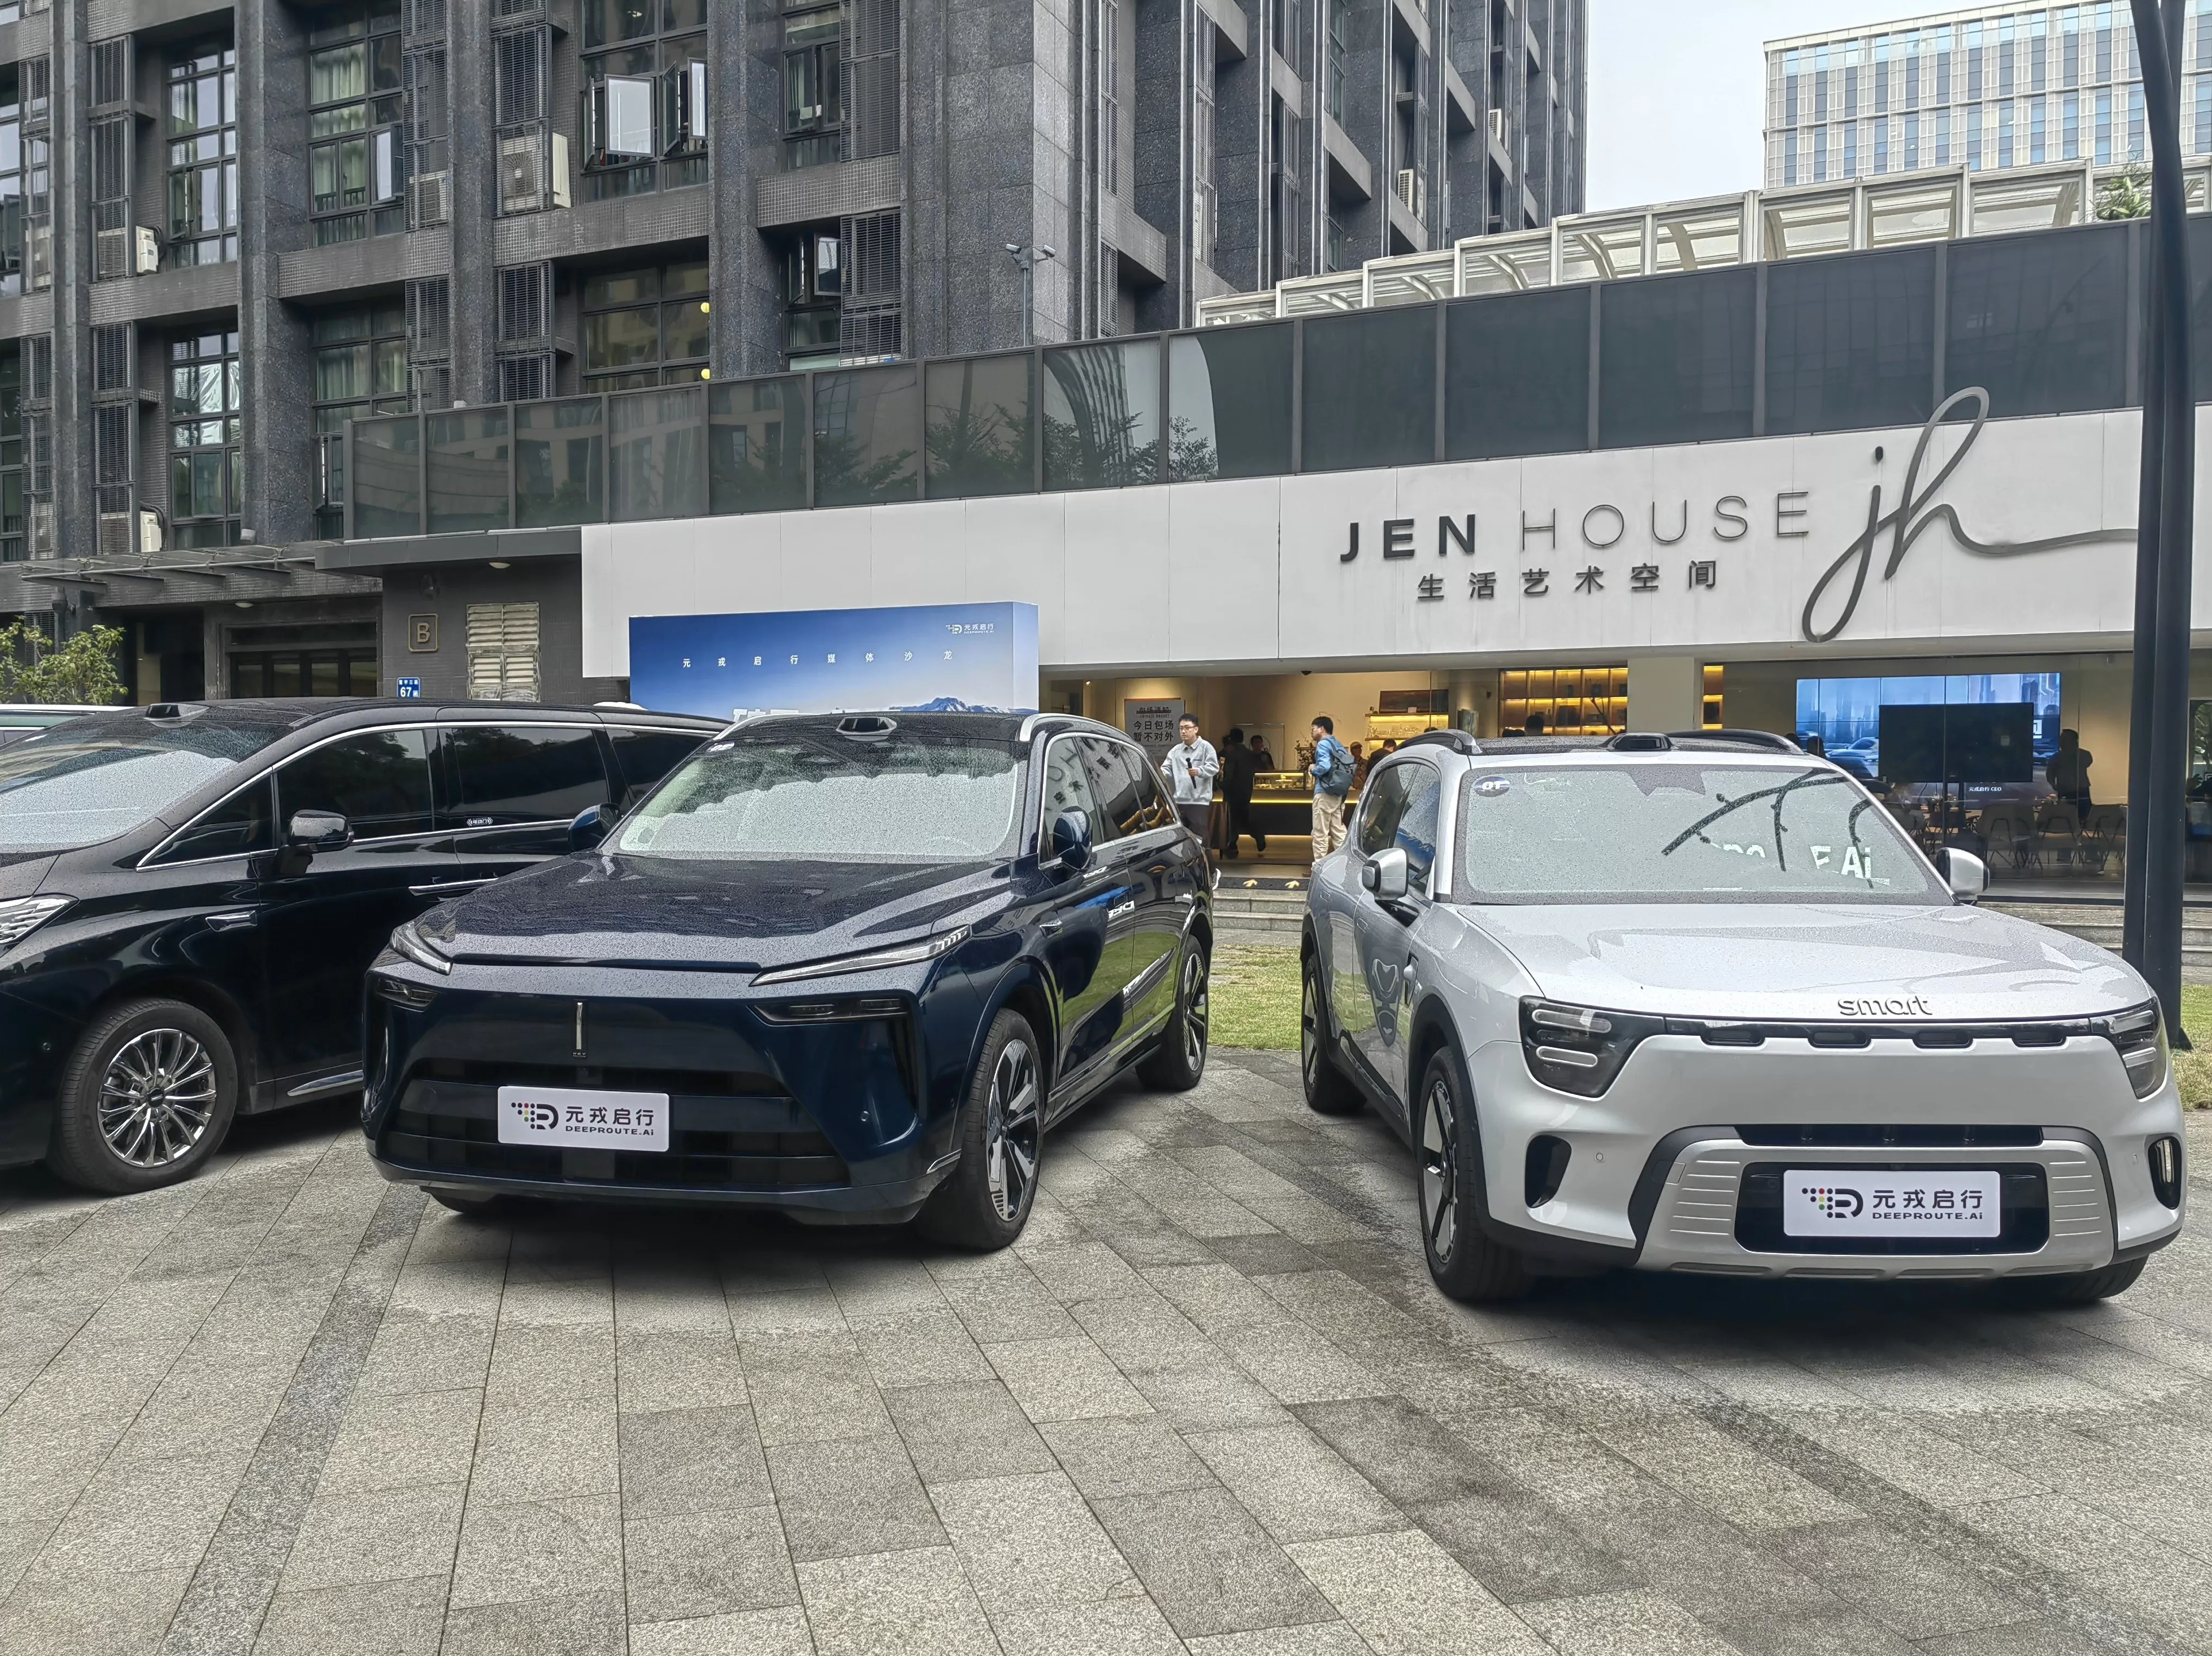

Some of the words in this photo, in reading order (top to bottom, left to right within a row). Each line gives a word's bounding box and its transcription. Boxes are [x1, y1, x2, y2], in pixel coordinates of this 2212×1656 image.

[1340, 514, 1476, 562] JEN
[1522, 491, 1809, 550] HOUSE
[1417, 560, 1717, 600] 生活艺术空间
[417, 622, 430, 642] B
[683, 649, 953, 668] 元戎启行媒体沙龙
[400, 686, 412, 697] 67
[1133, 719, 1174, 730] 今日包场
[1133, 731, 1174, 742] 暂不对外
[1838, 996, 1933, 1016] smart
[565, 1105, 654, 1126] 元戎启行
[565, 1126, 654, 1136] DEEPROUTE.Ai
[1872, 1189, 1982, 1209] 元戎启行
